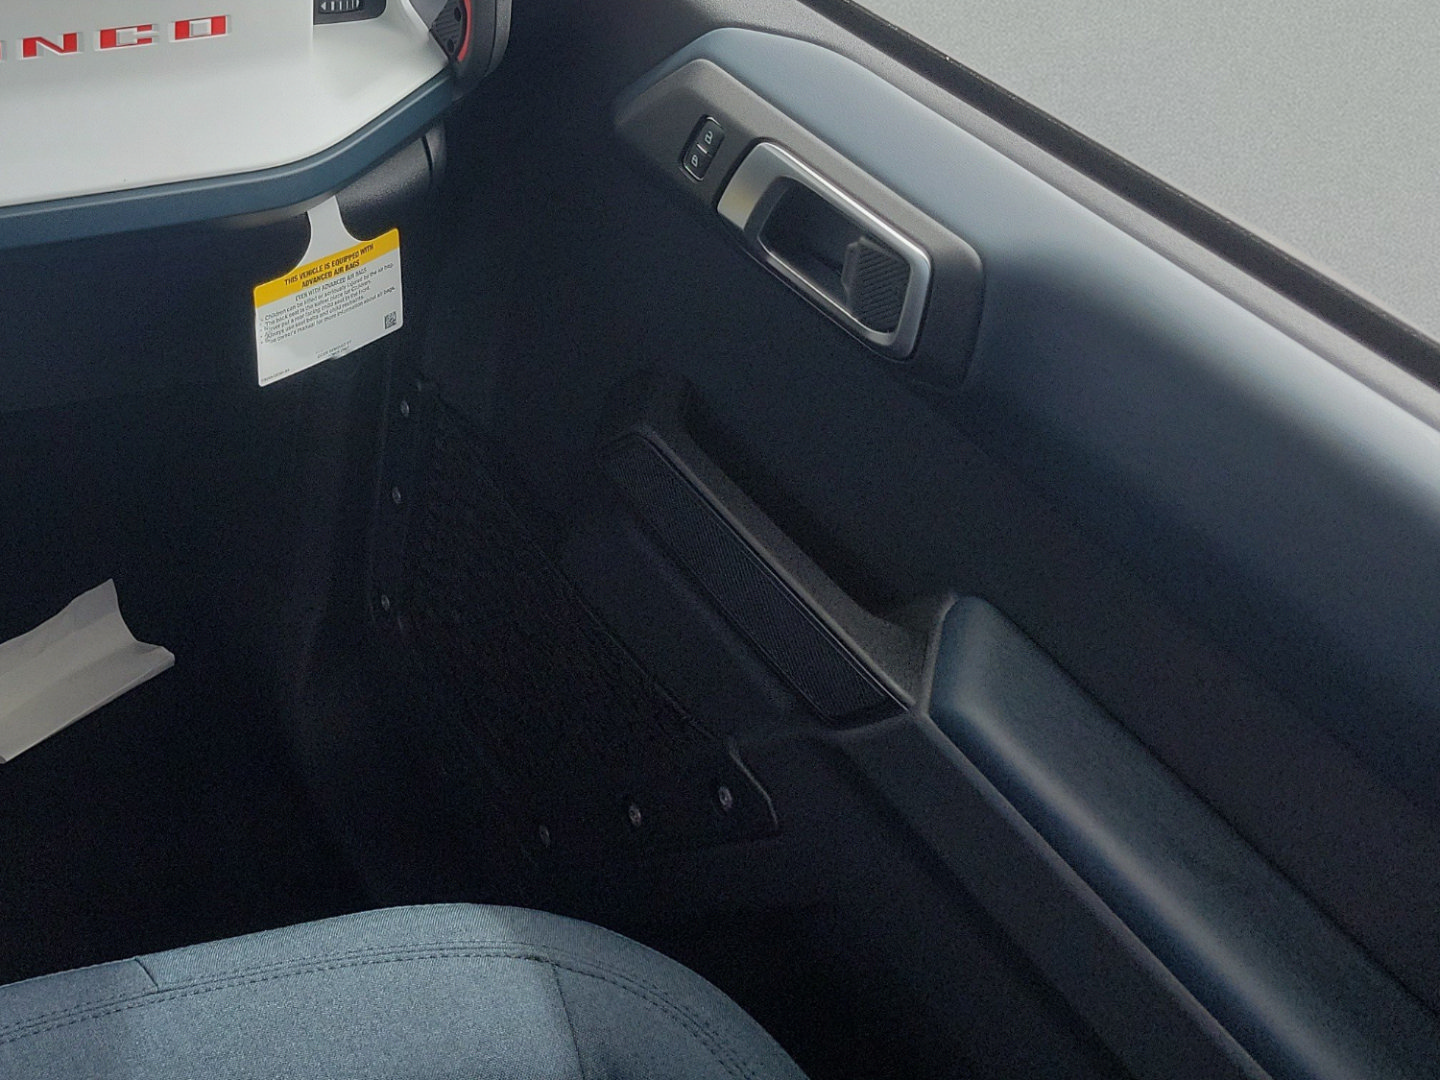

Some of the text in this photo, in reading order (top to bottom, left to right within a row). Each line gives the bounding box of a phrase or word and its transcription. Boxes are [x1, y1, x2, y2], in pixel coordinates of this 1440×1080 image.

[284, 275, 298, 286] THIS
[299, 265, 323, 280] VEHICLE
[332, 250, 359, 267] EQUIPPED
[360, 244, 373, 255] WITH
[302, 260, 359, 288] ADVANCED AIR BAGS
